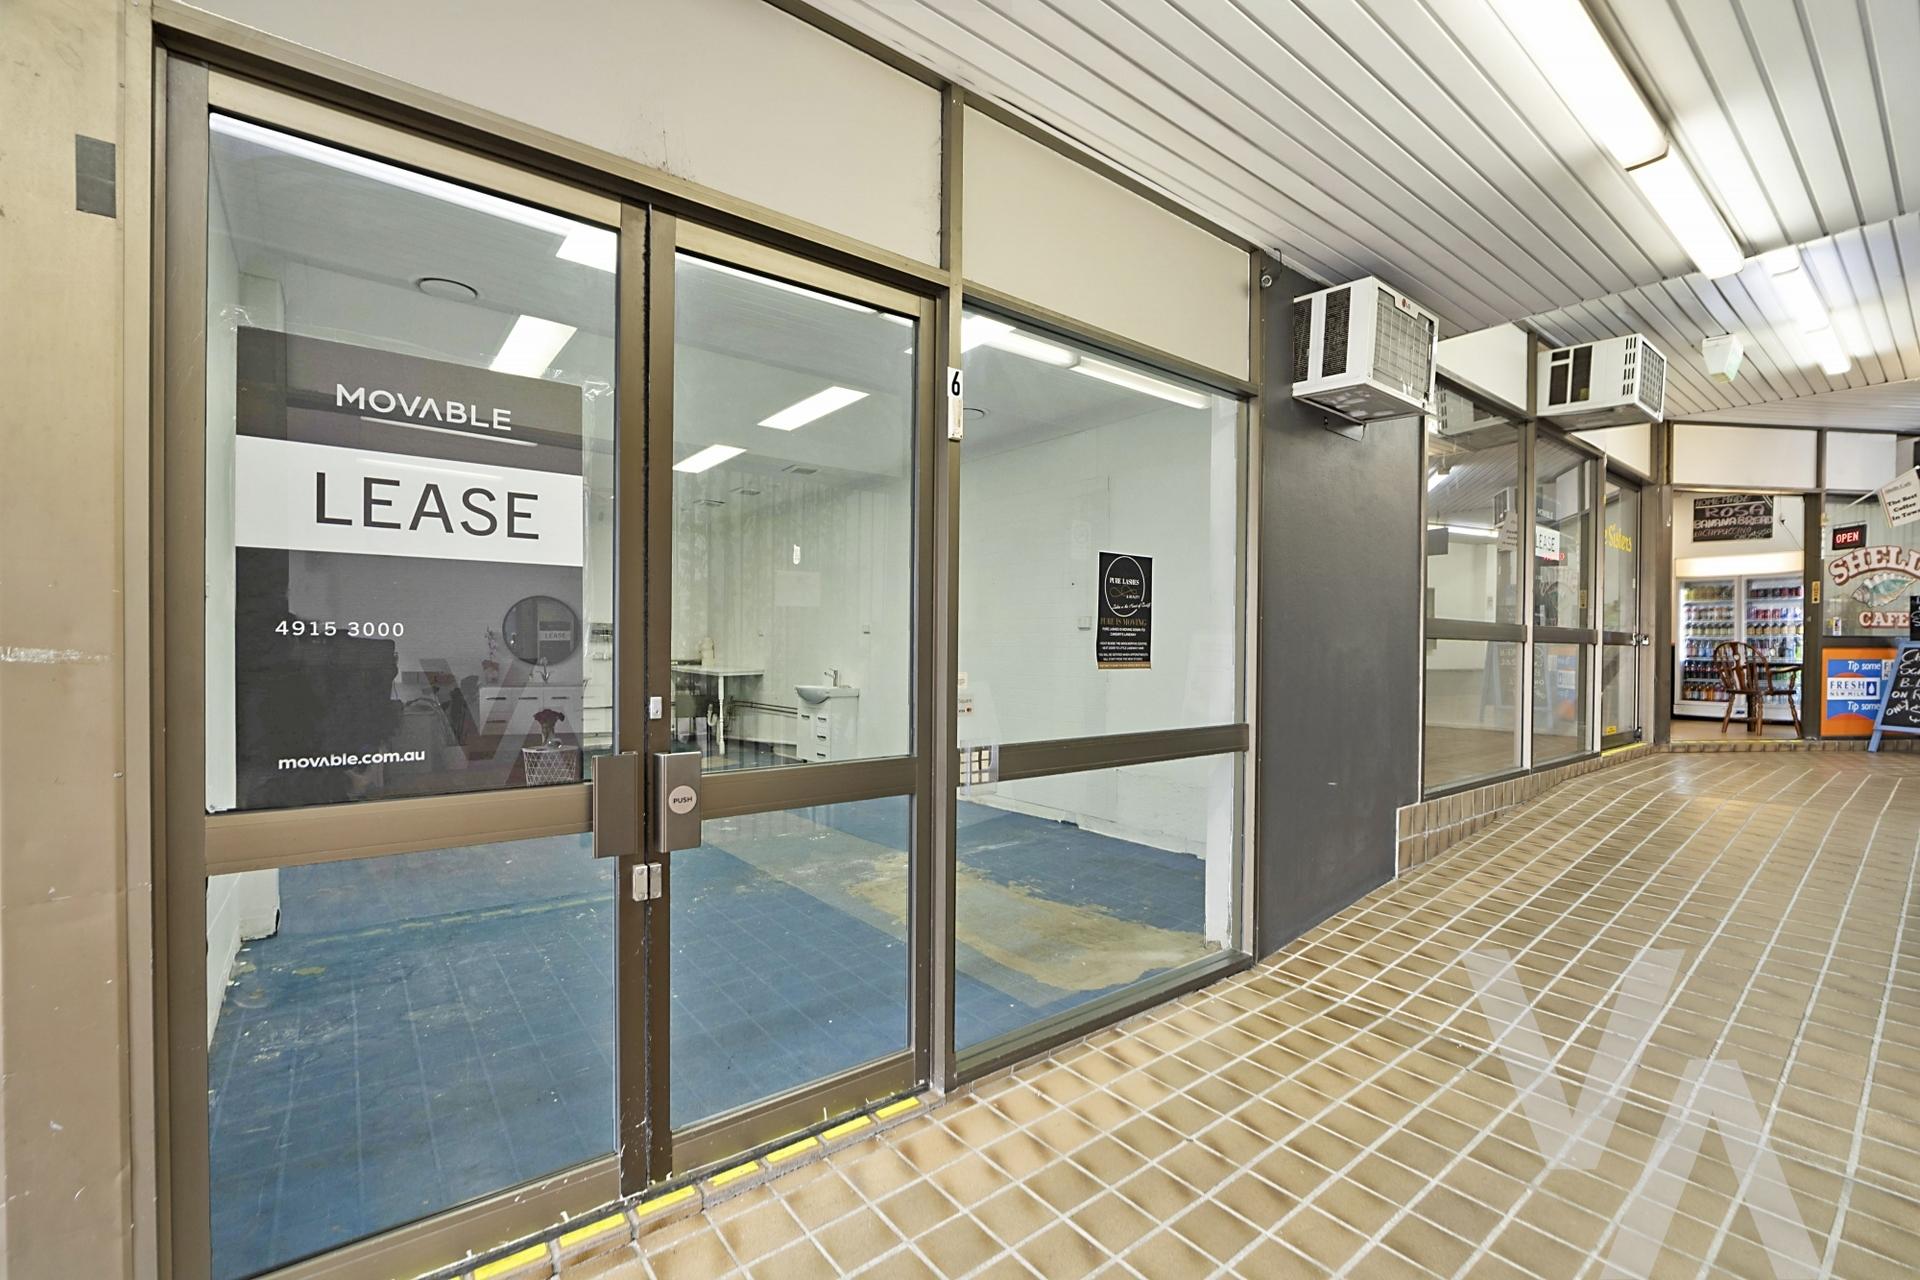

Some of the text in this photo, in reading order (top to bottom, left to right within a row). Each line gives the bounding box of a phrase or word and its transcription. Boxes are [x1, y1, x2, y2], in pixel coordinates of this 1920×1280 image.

[951, 371, 961, 396] 6
[335, 383, 512, 432] MOVABLE
[315, 471, 540, 541] LEASE
[1887, 493, 1918, 507] The Best
[1893, 502, 1916, 513] Coffee
[1704, 503, 1766, 518] ROSA
[1695, 515, 1773, 530] BANANA BREAD
[1836, 531, 1860, 544] OPEN
[1859, 612, 1910, 629] CAFE
[274, 620, 405, 638] 4915 3000
[1847, 660, 1860, 673] Tip
[1861, 662, 1881, 671] some
[1830, 680, 1865, 690] FRESH
[1891, 690, 1908, 699] ON
[1847, 701, 1860, 713] Tip
[1886, 698, 1909, 716] ONLY
[277, 750, 426, 770] movable.com.au
[672, 795, 693, 805] PUSH
